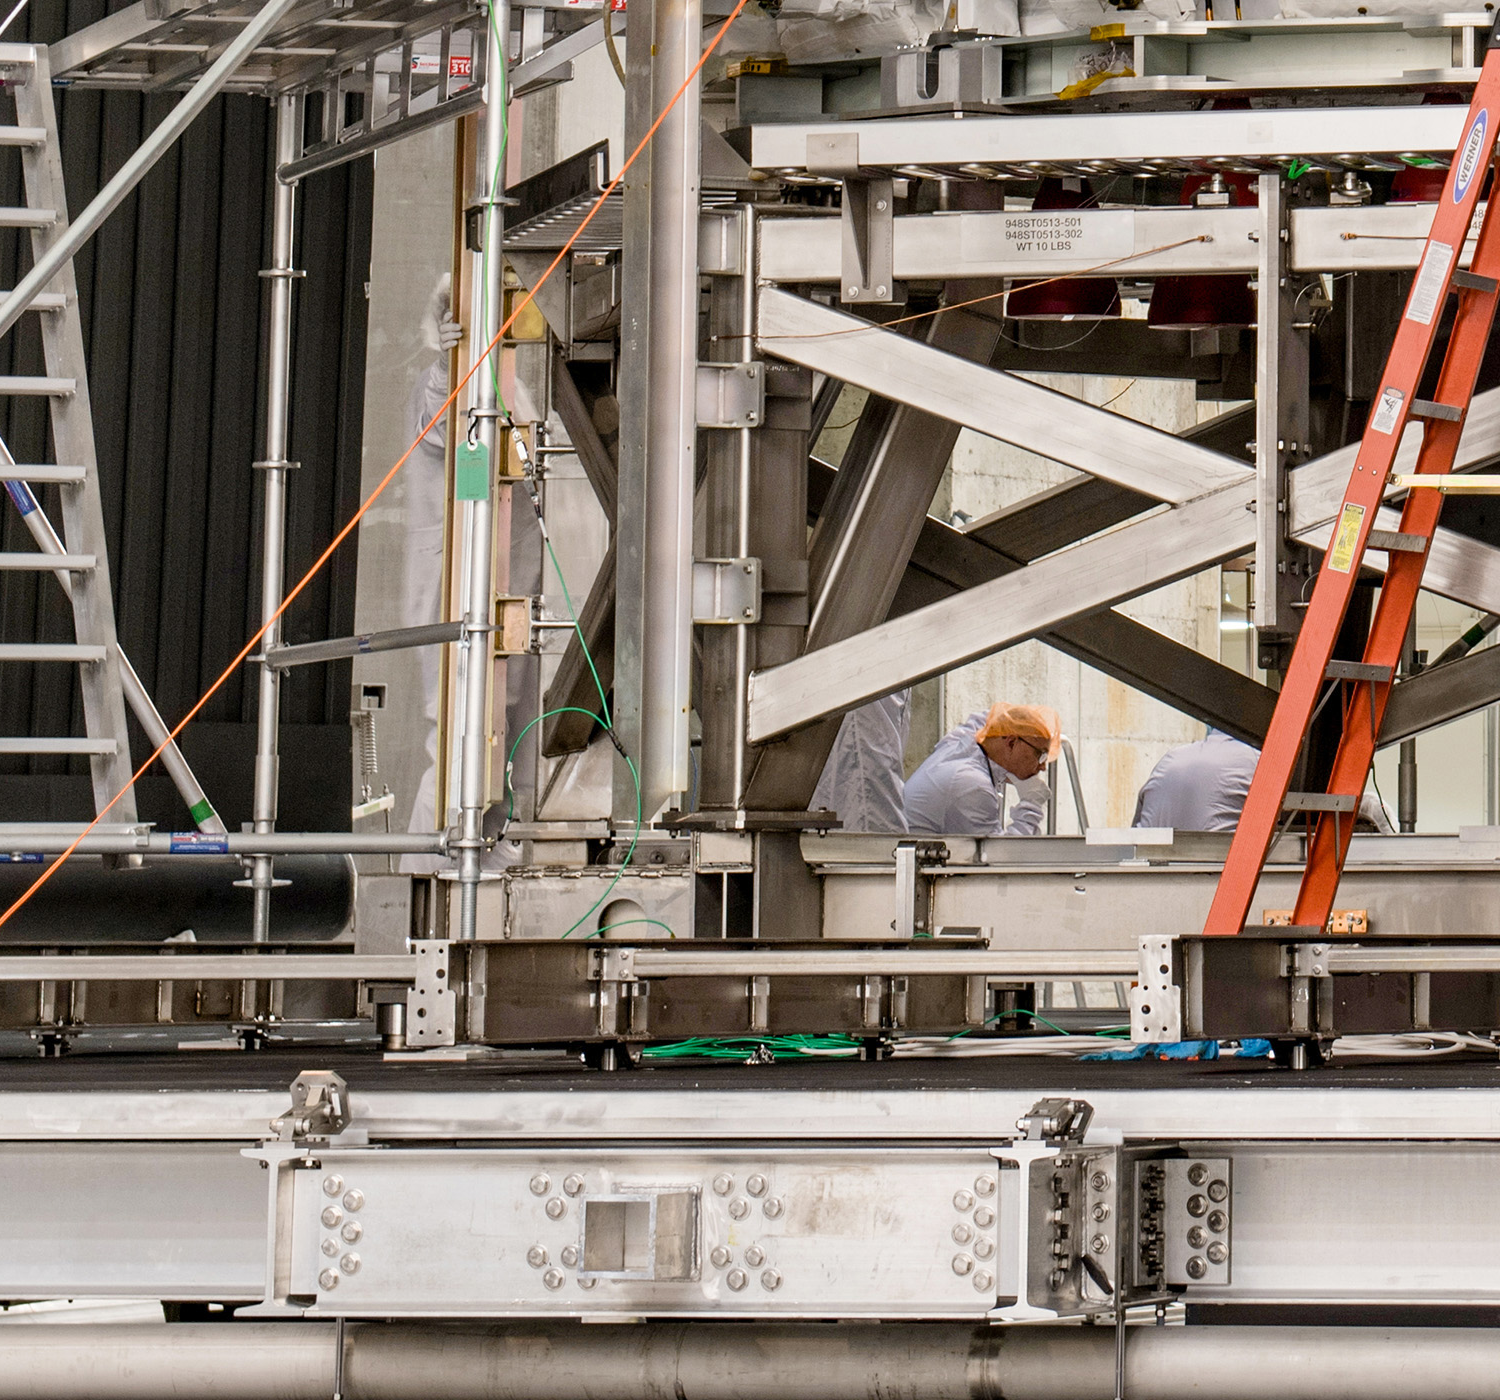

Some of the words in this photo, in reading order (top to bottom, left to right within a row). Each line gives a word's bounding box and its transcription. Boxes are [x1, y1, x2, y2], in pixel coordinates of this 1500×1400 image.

[451, 64, 471, 73] 310
[1460, 128, 1482, 184] WERNER
[1005, 218, 1082, 229] 948ST0513-501
[1005, 230, 1083, 239] 948ST0513-302
[1016, 241, 1034, 251] WT
[1036, 241, 1048, 251] 10
[1051, 241, 1072, 251] LBS
